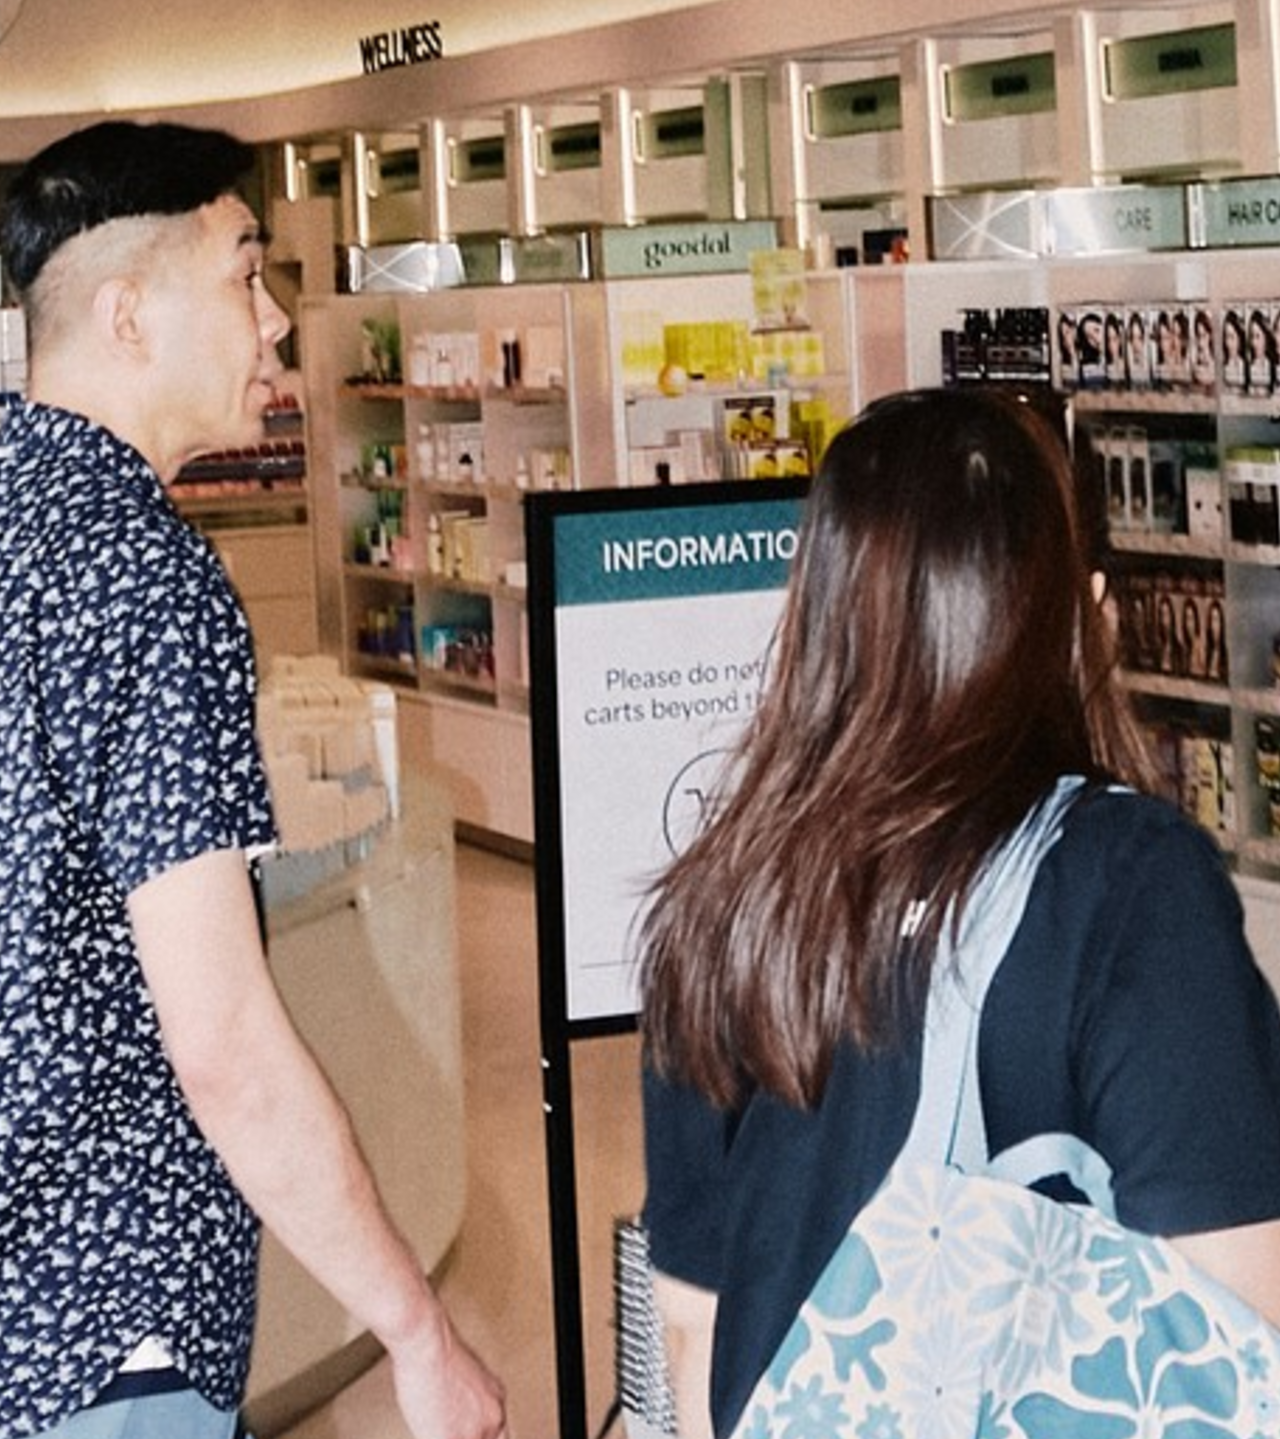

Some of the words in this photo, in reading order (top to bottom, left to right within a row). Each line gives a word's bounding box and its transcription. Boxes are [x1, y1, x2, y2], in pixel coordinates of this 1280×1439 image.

[359, 19, 443, 76] WELLNESS
[1228, 200, 1262, 226] HAIR
[644, 229, 731, 270] goodal
[605, 667, 682, 691] Please
[687, 661, 719, 686] do
[584, 703, 646, 726] carts
[651, 689, 739, 722] beyond
